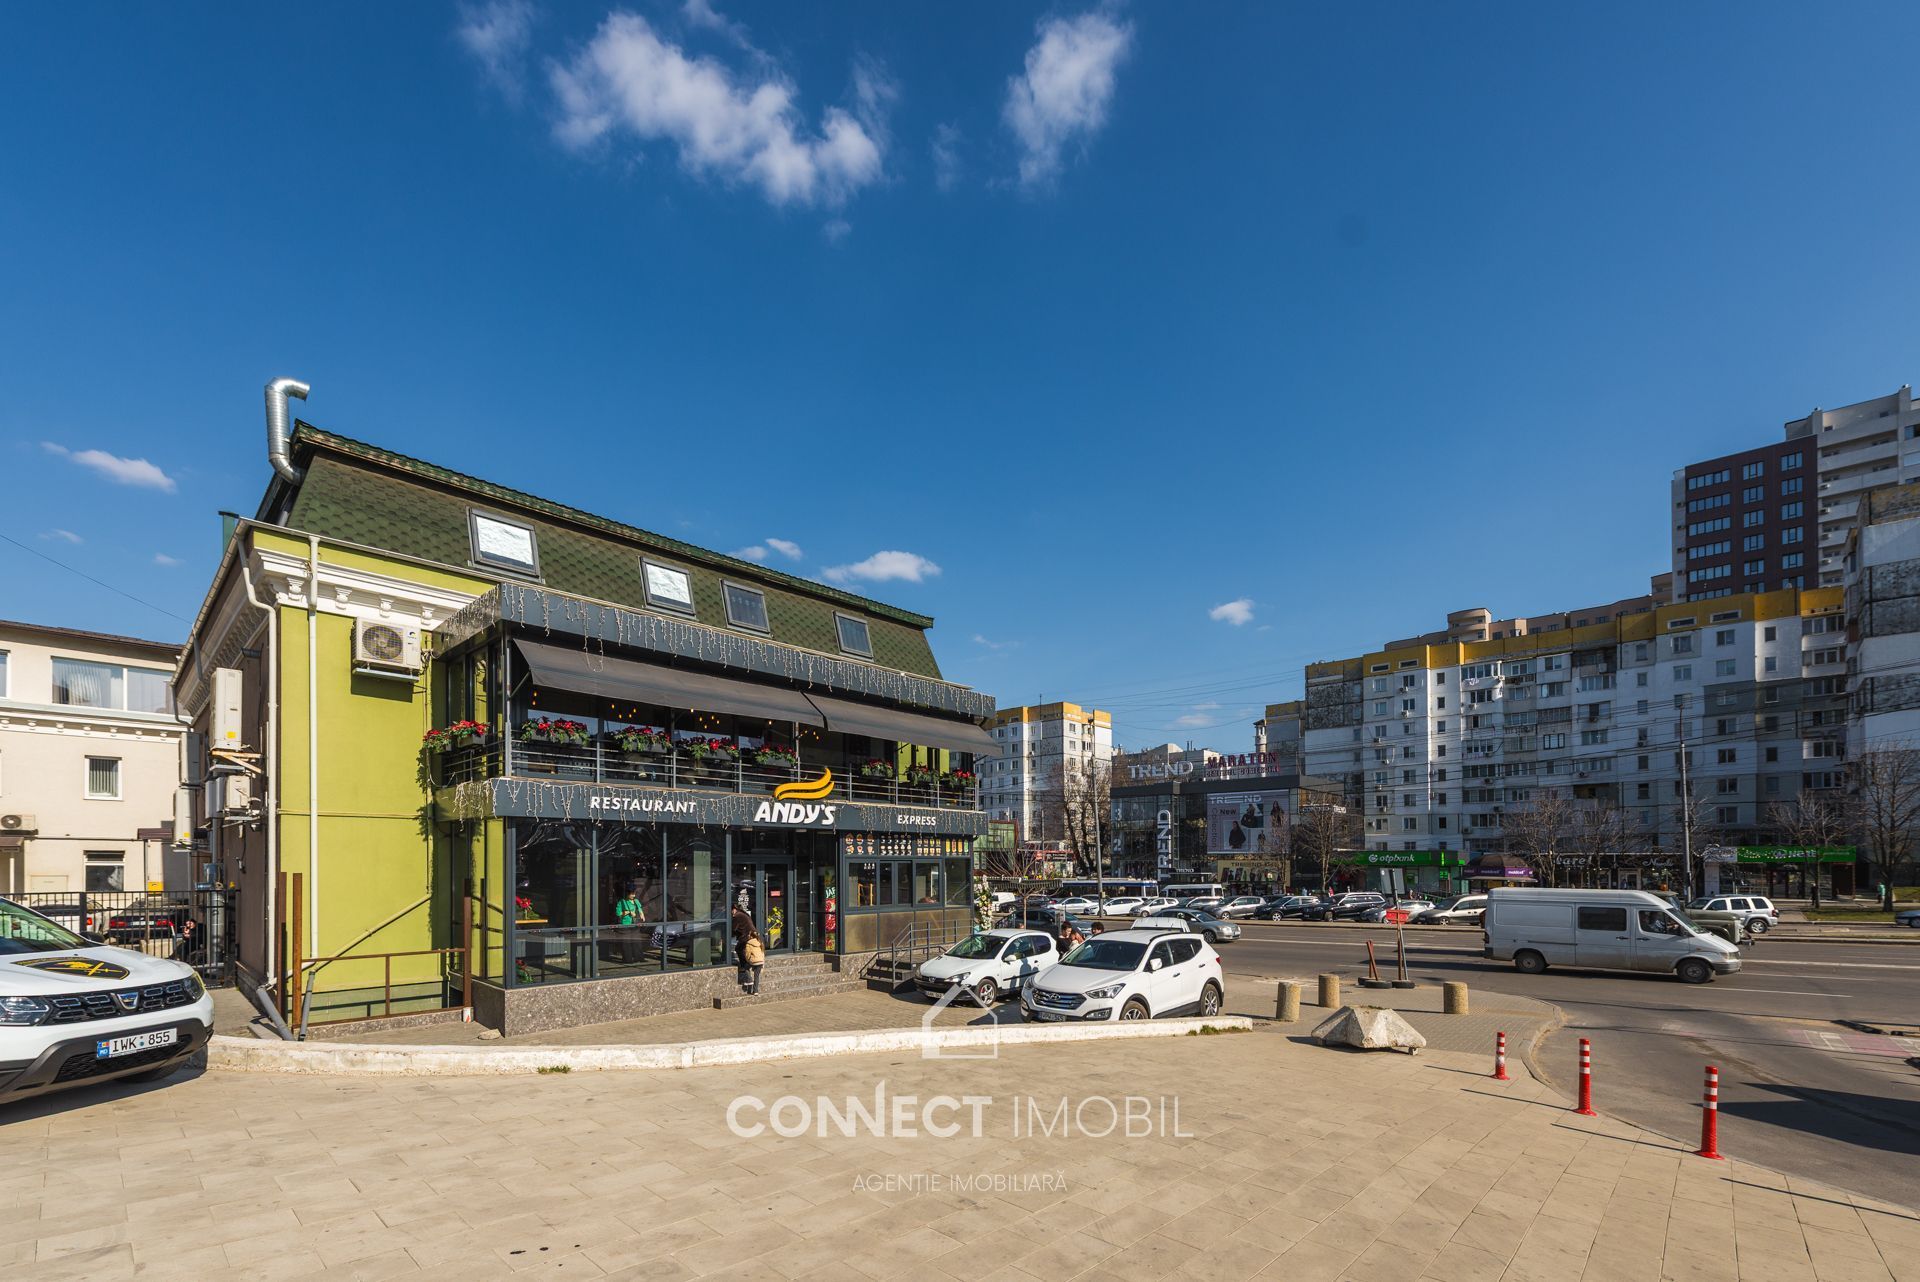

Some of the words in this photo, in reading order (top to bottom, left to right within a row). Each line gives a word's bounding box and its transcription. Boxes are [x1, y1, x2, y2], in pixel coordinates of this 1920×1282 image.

[1206, 751, 1279, 769] MARATON
[1127, 760, 1194, 779] TREND
[590, 796, 697, 814] RESTAURANT
[753, 801, 837, 826] ANDY'S
[897, 814, 937, 826] EXPRESS
[1157, 809, 1172, 882] TREND
[1379, 854, 1415, 863] otpbank
[112, 1036, 138, 1053] IWK
[148, 1031, 171, 1046] 855
